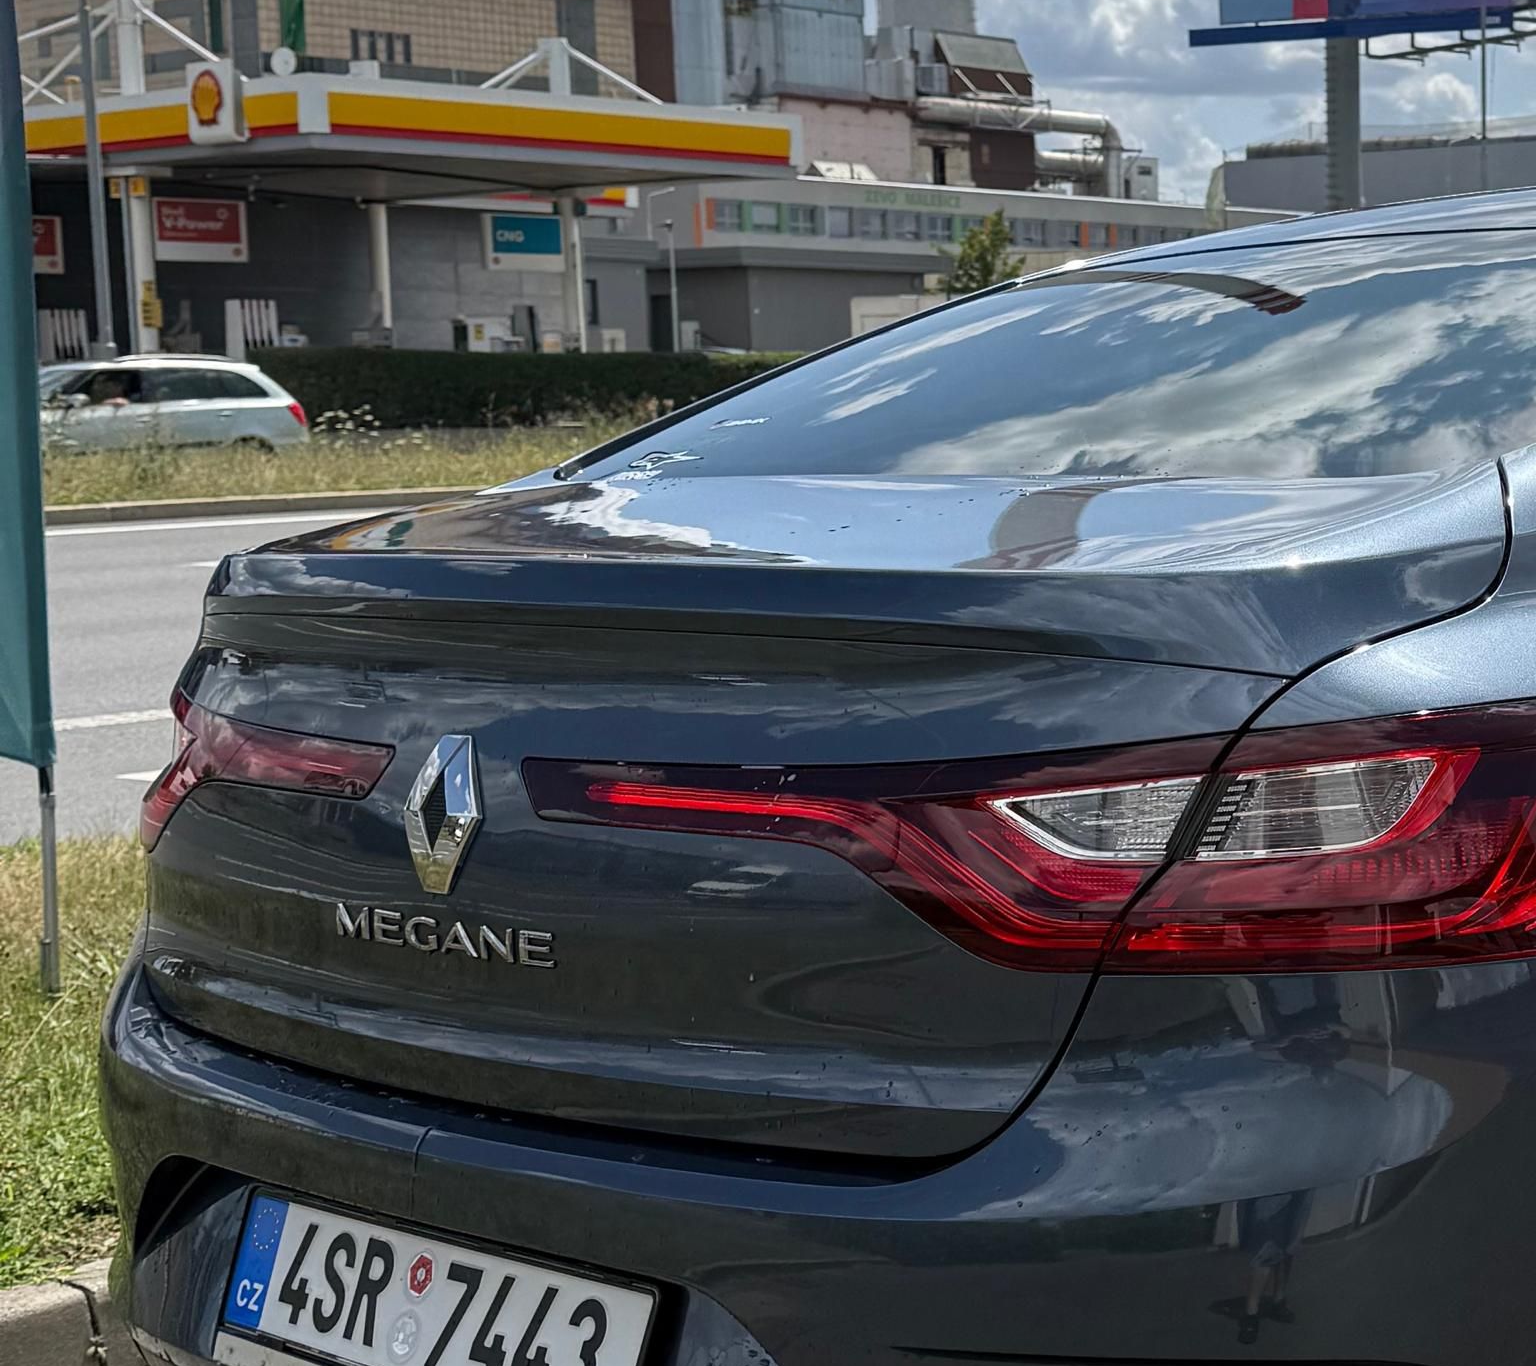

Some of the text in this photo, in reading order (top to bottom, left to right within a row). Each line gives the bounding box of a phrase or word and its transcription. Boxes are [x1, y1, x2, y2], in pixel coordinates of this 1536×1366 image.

[335, 902, 555, 968] MEGANE
[236, 1278, 265, 1313] CZ
[278, 1223, 395, 1348] 4SR
